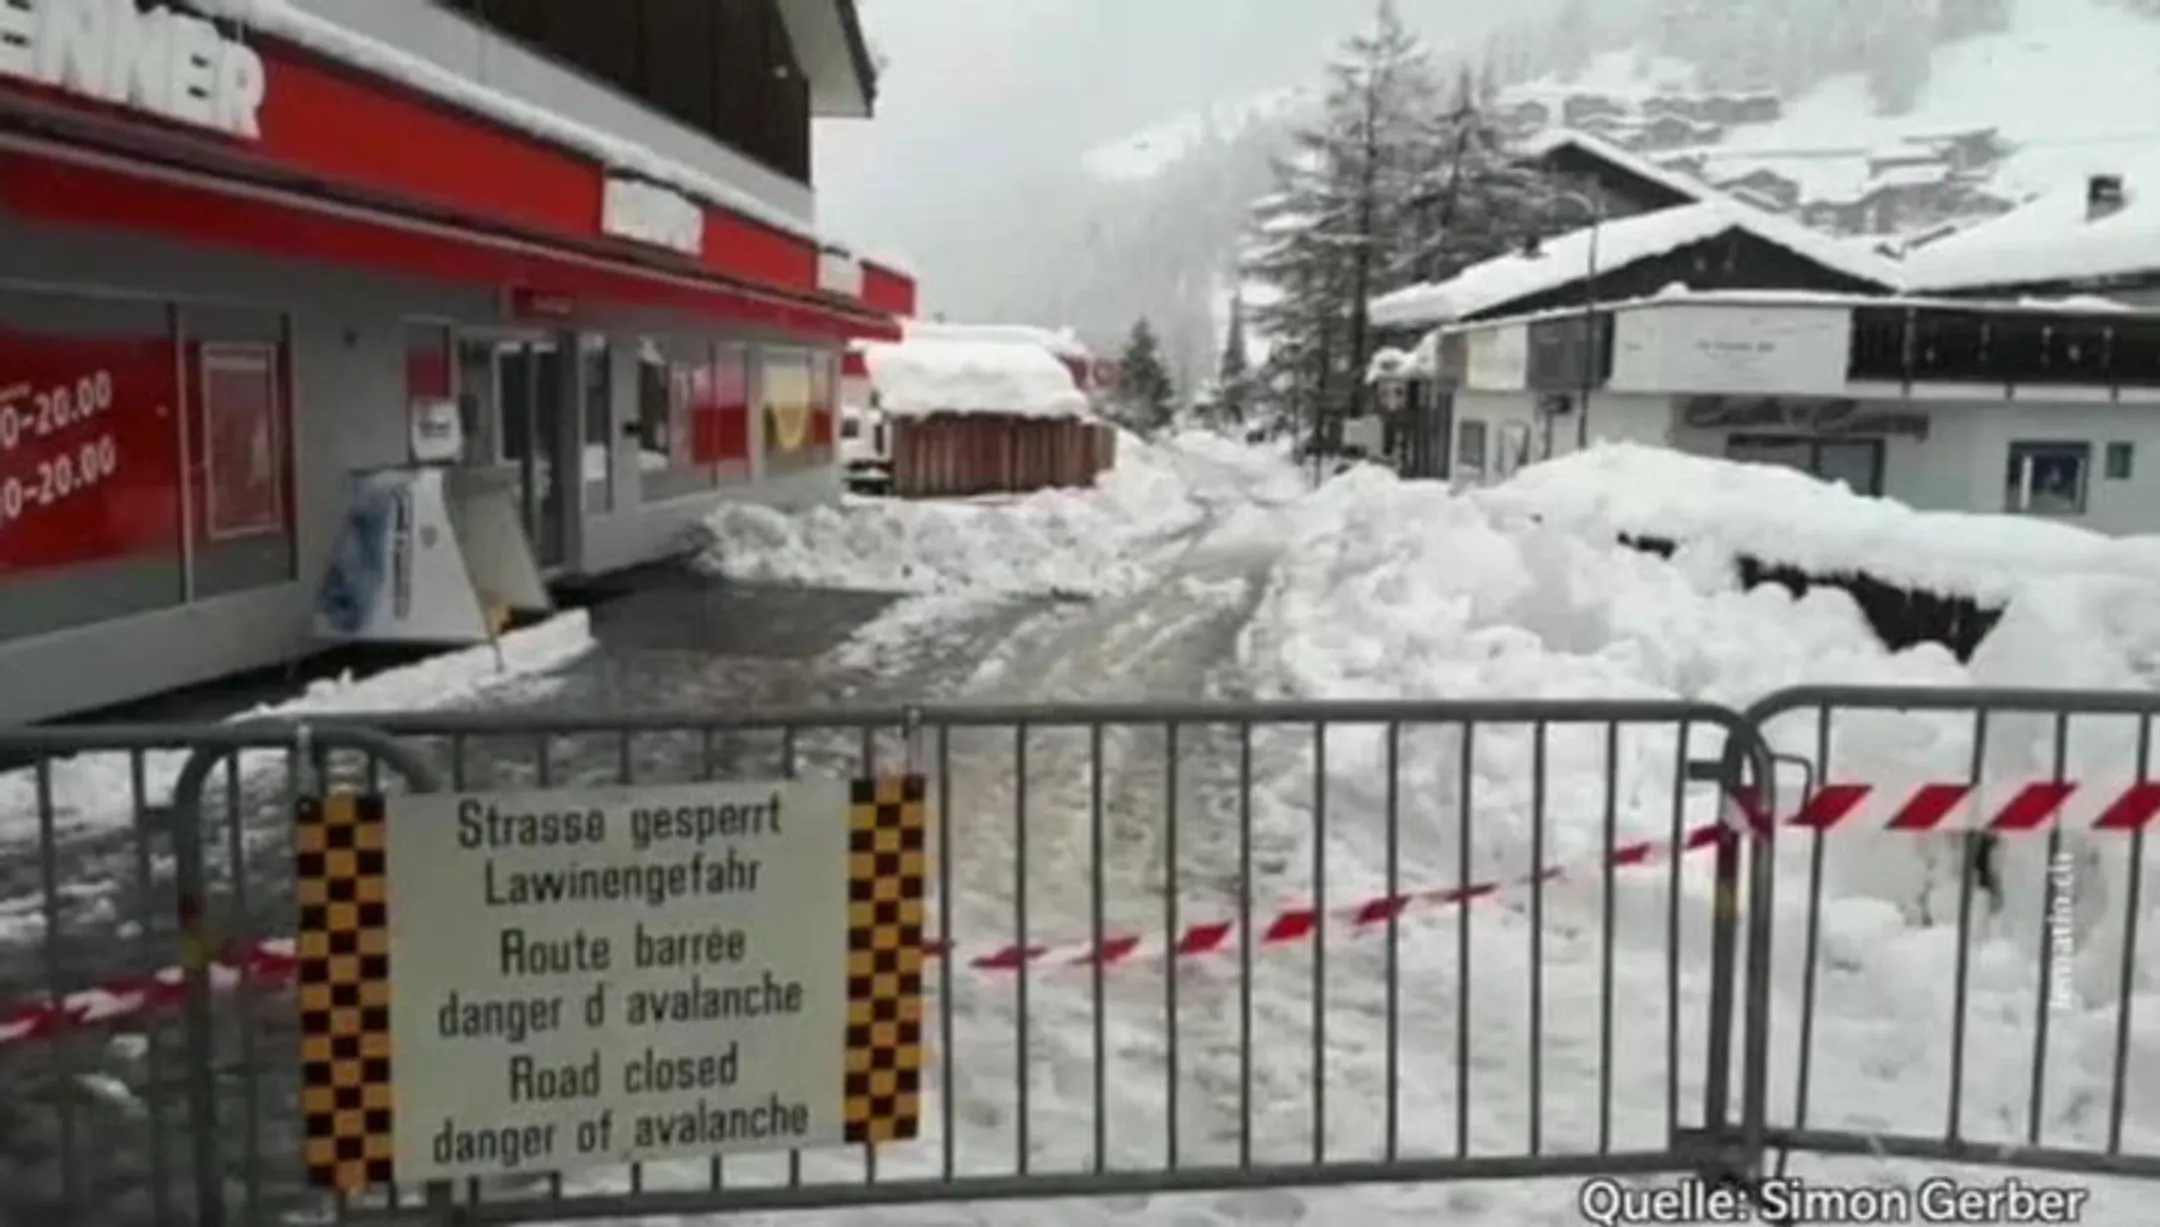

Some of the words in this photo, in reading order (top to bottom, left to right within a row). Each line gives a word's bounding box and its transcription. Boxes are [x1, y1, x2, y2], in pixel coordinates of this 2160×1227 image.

[457, 799, 606, 848] Strasse
[630, 797, 782, 847] gesperrt
[485, 849, 762, 906] Lawinengefahr
[500, 927, 611, 976] Route
[438, 991, 562, 1043] danger
[627, 971, 803, 1026] avalanche
[510, 1052, 602, 1102] Road
[624, 1042, 739, 1093] closed
[432, 1117, 555, 1168] danger
[577, 1112, 610, 1153] of
[635, 1093, 809, 1149] avalanche
